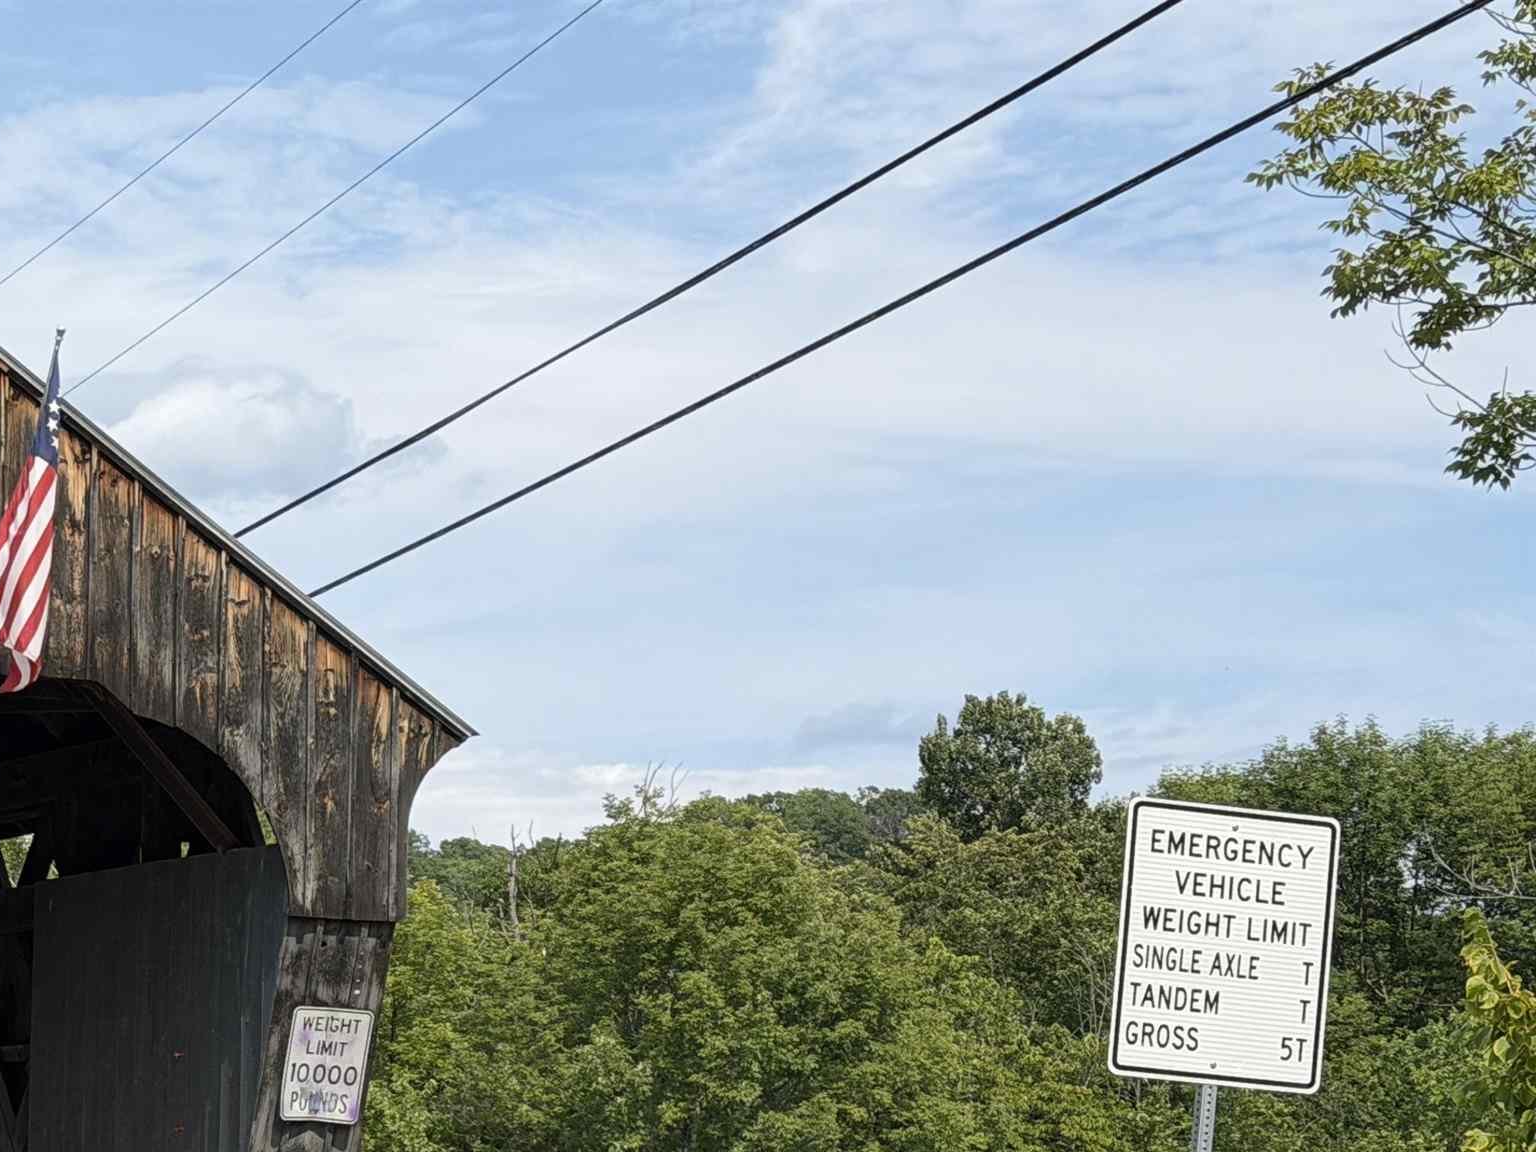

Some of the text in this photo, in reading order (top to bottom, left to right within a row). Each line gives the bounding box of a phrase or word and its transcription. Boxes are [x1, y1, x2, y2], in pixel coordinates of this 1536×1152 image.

[1150, 828, 1315, 870] EMERGENCY
[1175, 869, 1286, 906] VEHICLE
[1142, 904, 1313, 947] WEIGHT LIMIT
[1132, 943, 1314, 986] SINGLE AXLE T
[1129, 981, 1312, 1024] TANDEM T
[303, 1015, 362, 1034] WEIGHT
[1125, 1020, 1308, 1063] GROSS 5T
[305, 1039, 349, 1057] LIMIT
[290, 1062, 359, 1086] 10000
